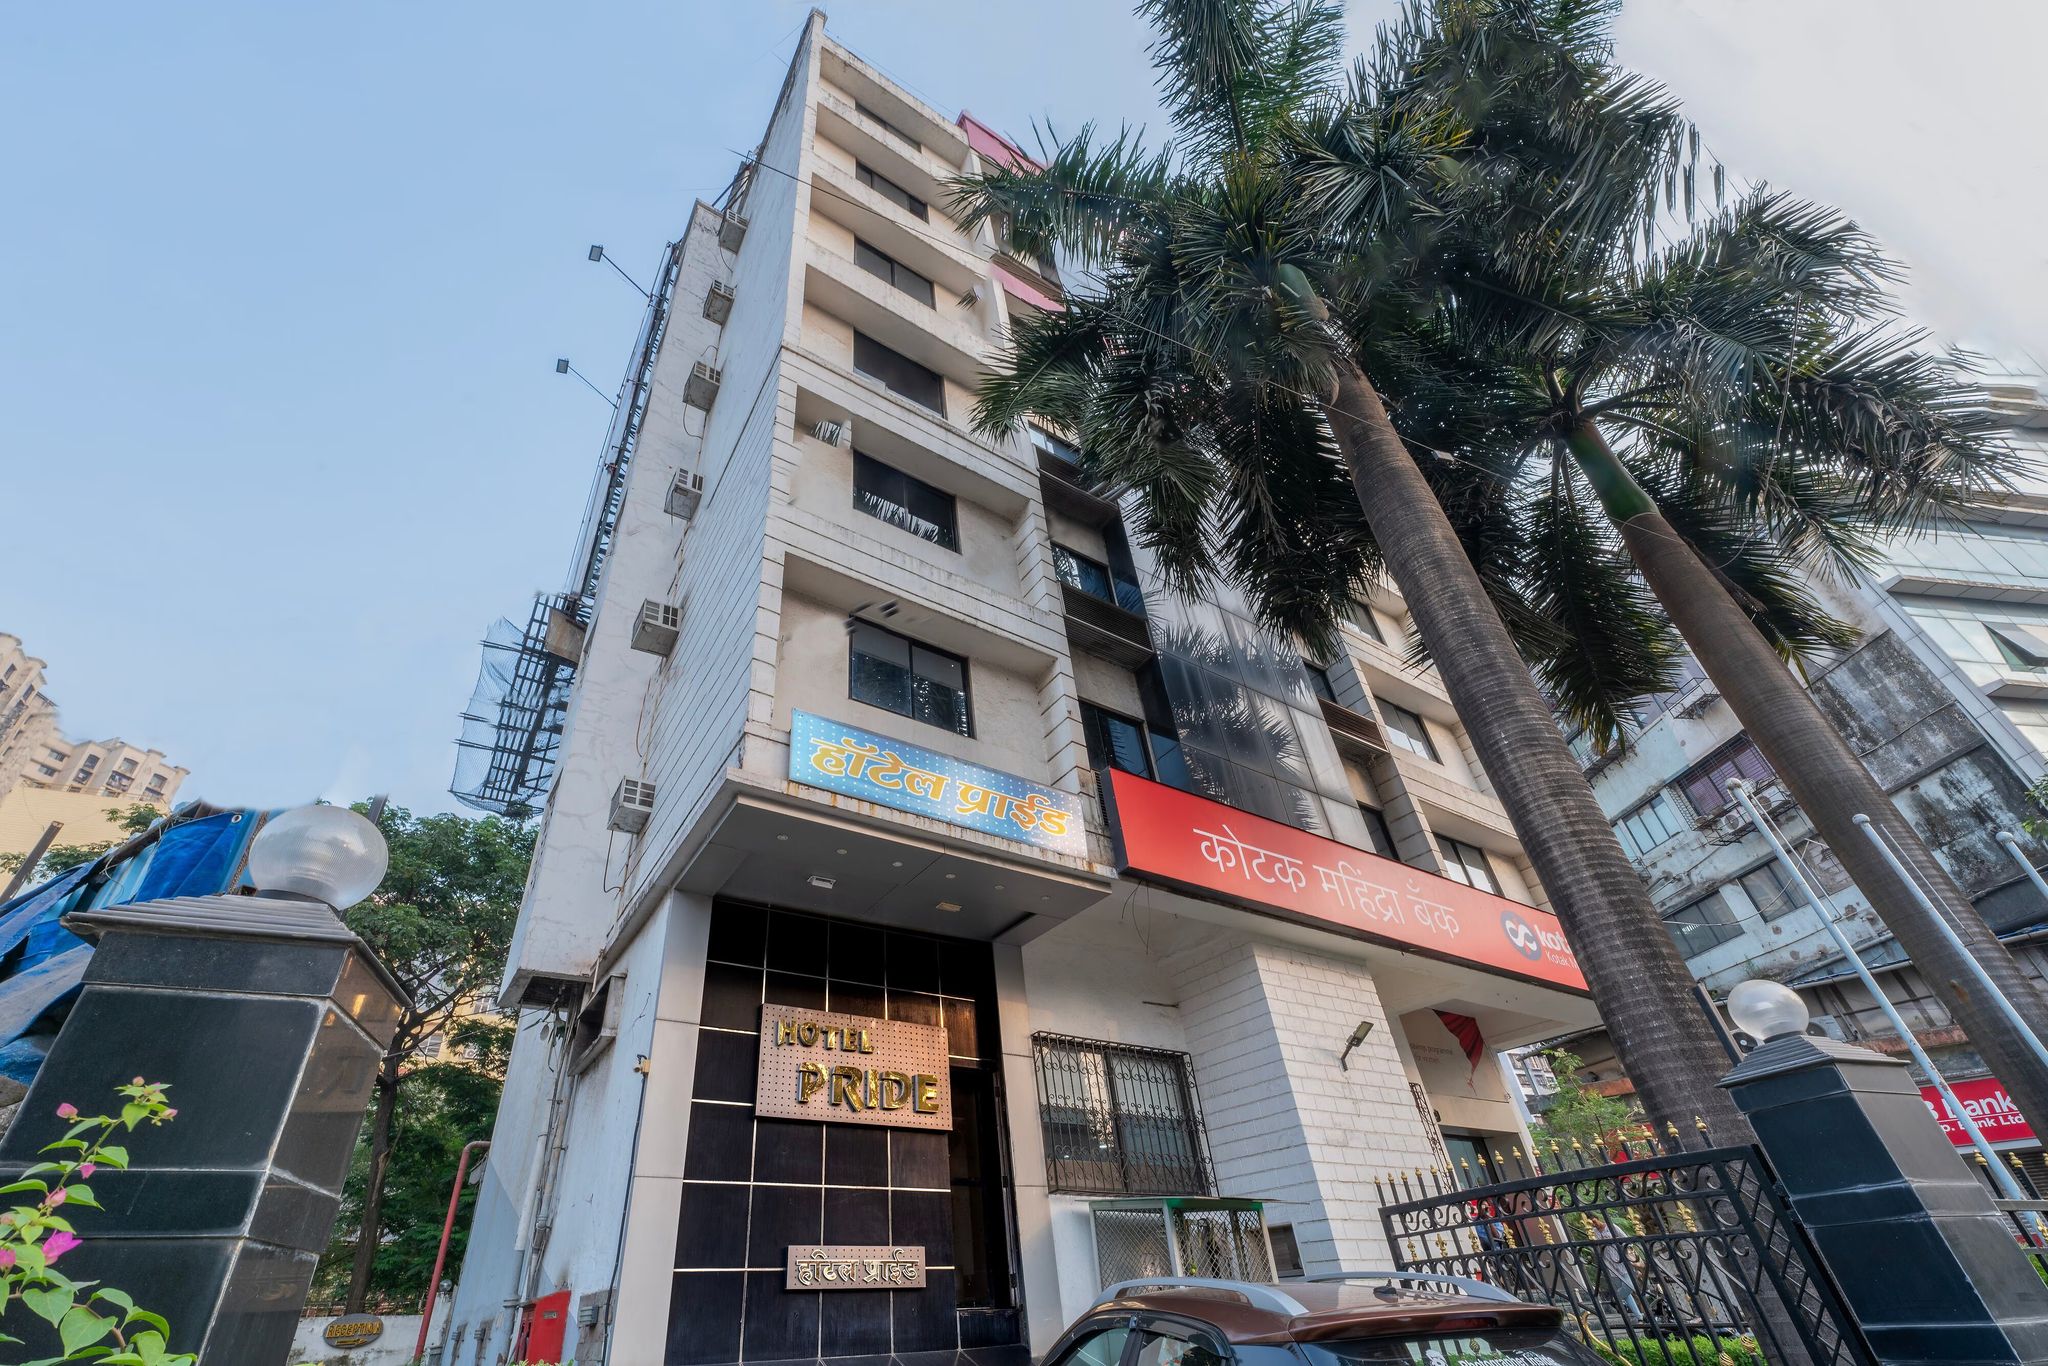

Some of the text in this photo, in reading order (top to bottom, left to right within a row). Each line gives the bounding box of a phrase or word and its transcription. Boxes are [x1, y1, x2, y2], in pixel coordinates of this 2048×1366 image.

[810, 737, 1073, 836] हॉटेल प्राईड
[1192, 824, 1460, 939] कोटक महिंद्रा बँक
[776, 1018, 874, 1054] HOTEL
[798, 1061, 940, 1114] PRIDE
[863, 1248, 920, 1285] प्राईड
